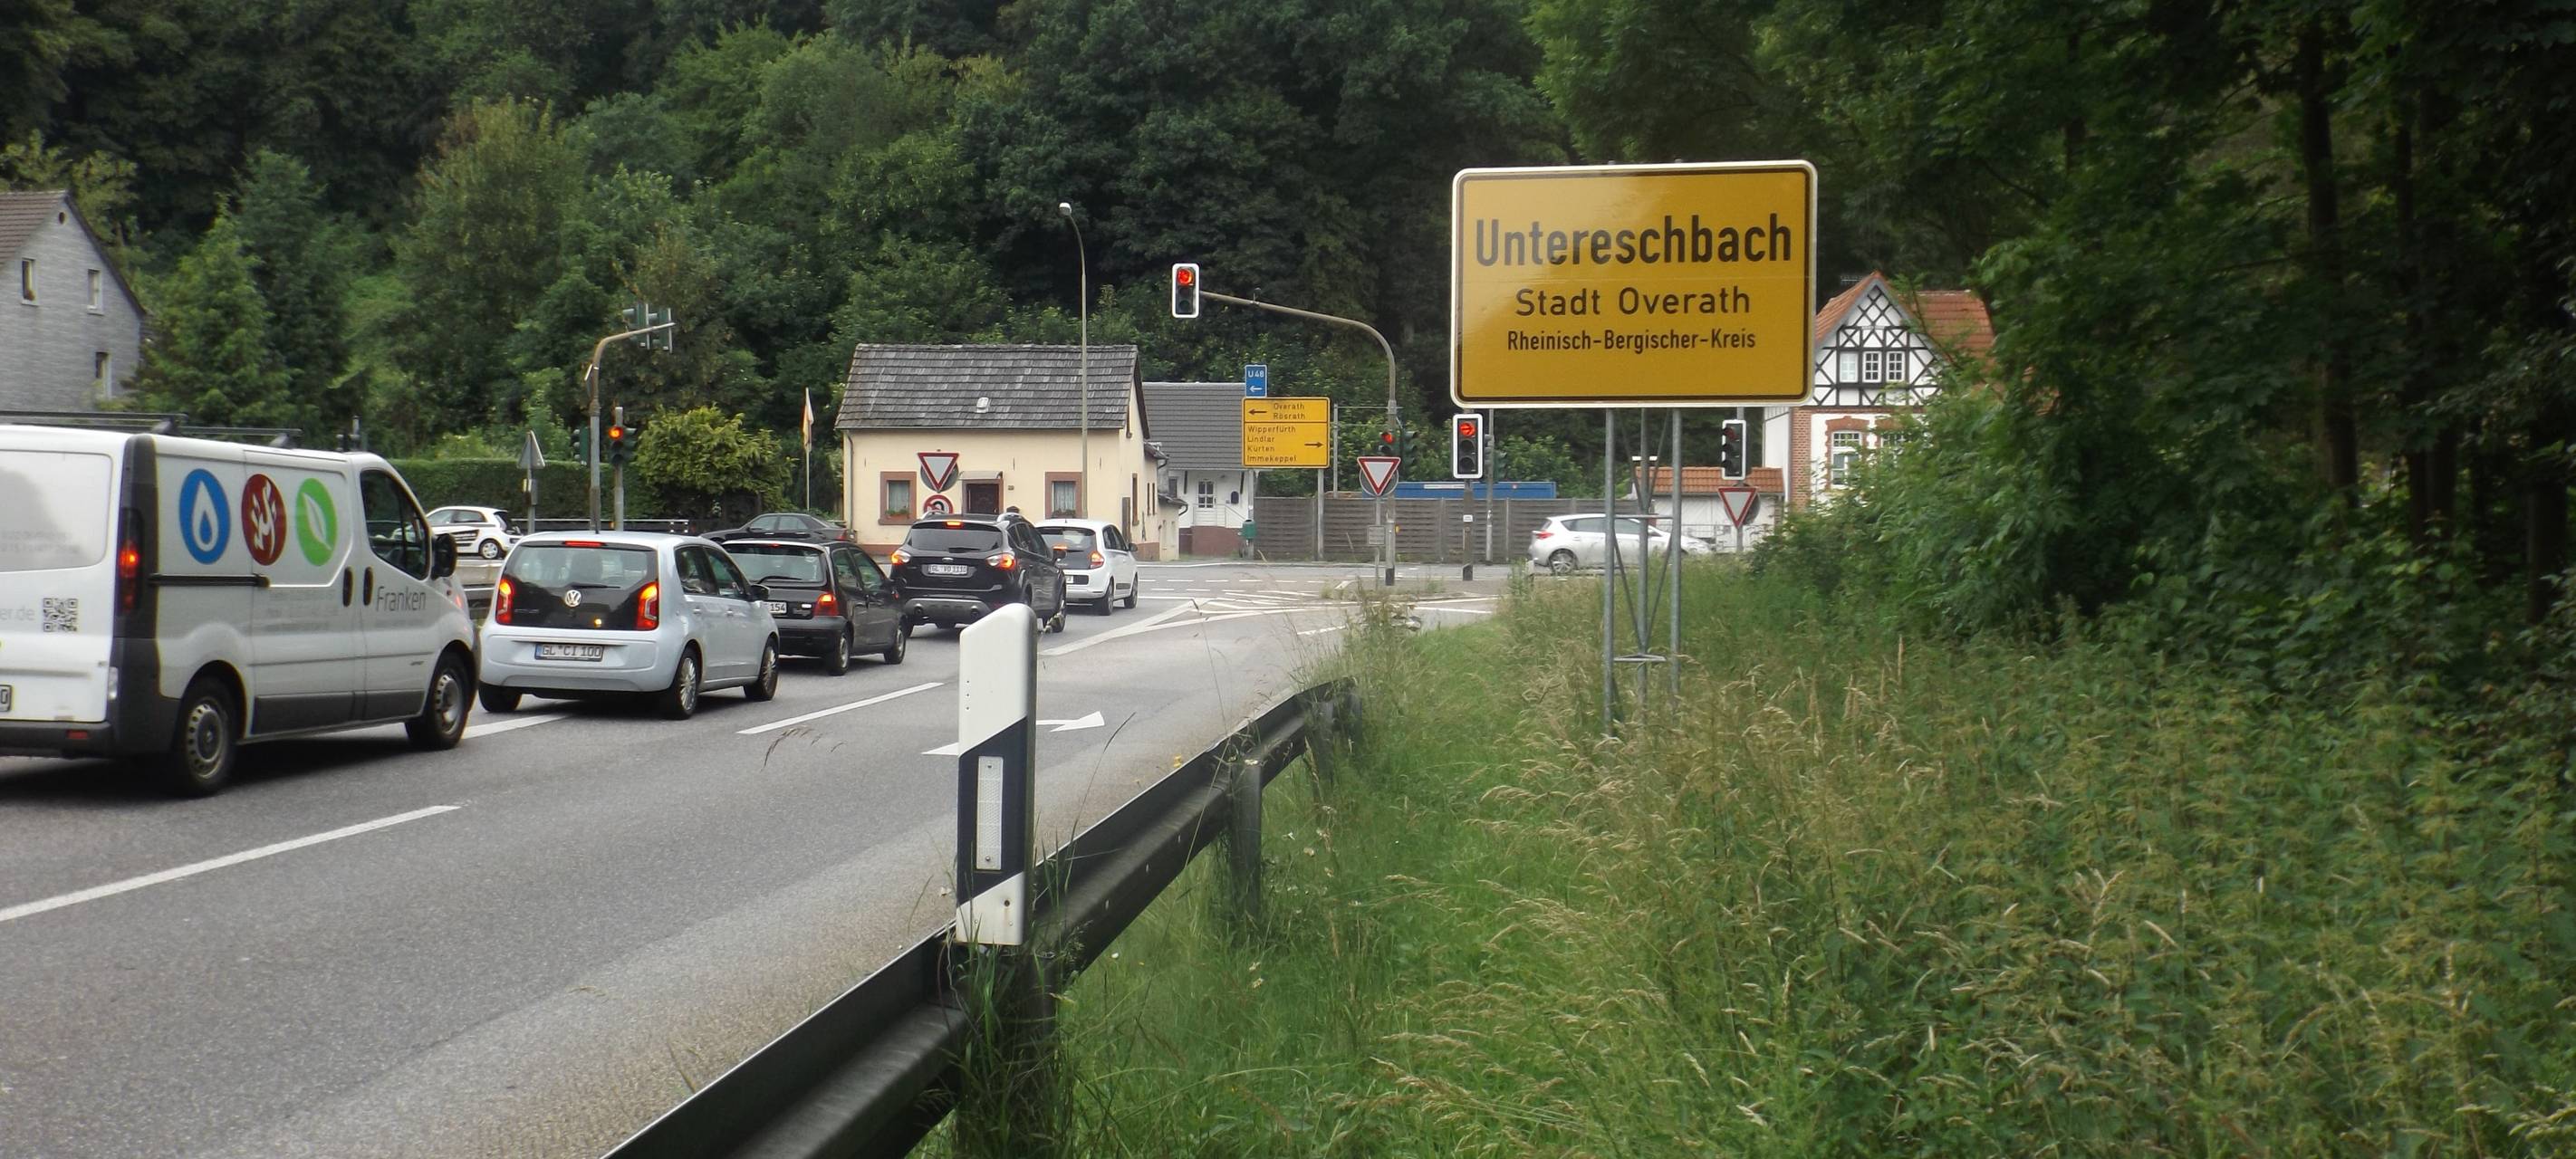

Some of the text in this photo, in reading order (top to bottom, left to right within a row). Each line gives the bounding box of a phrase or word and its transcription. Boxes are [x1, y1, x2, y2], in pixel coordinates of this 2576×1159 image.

[1475, 213, 1793, 267] Untereschbach
[1514, 285, 1750, 316] Stadt Overath
[1507, 328, 1756, 354] Rheinisch-Bergischer-Kreis
[1274, 402, 1305, 410] Overath
[1247, 426, 1296, 434] Wipperfürth
[1246, 455, 1297, 463] Immekeppel
[376, 586, 427, 612] Franken
[542, 644, 555, 656] GL
